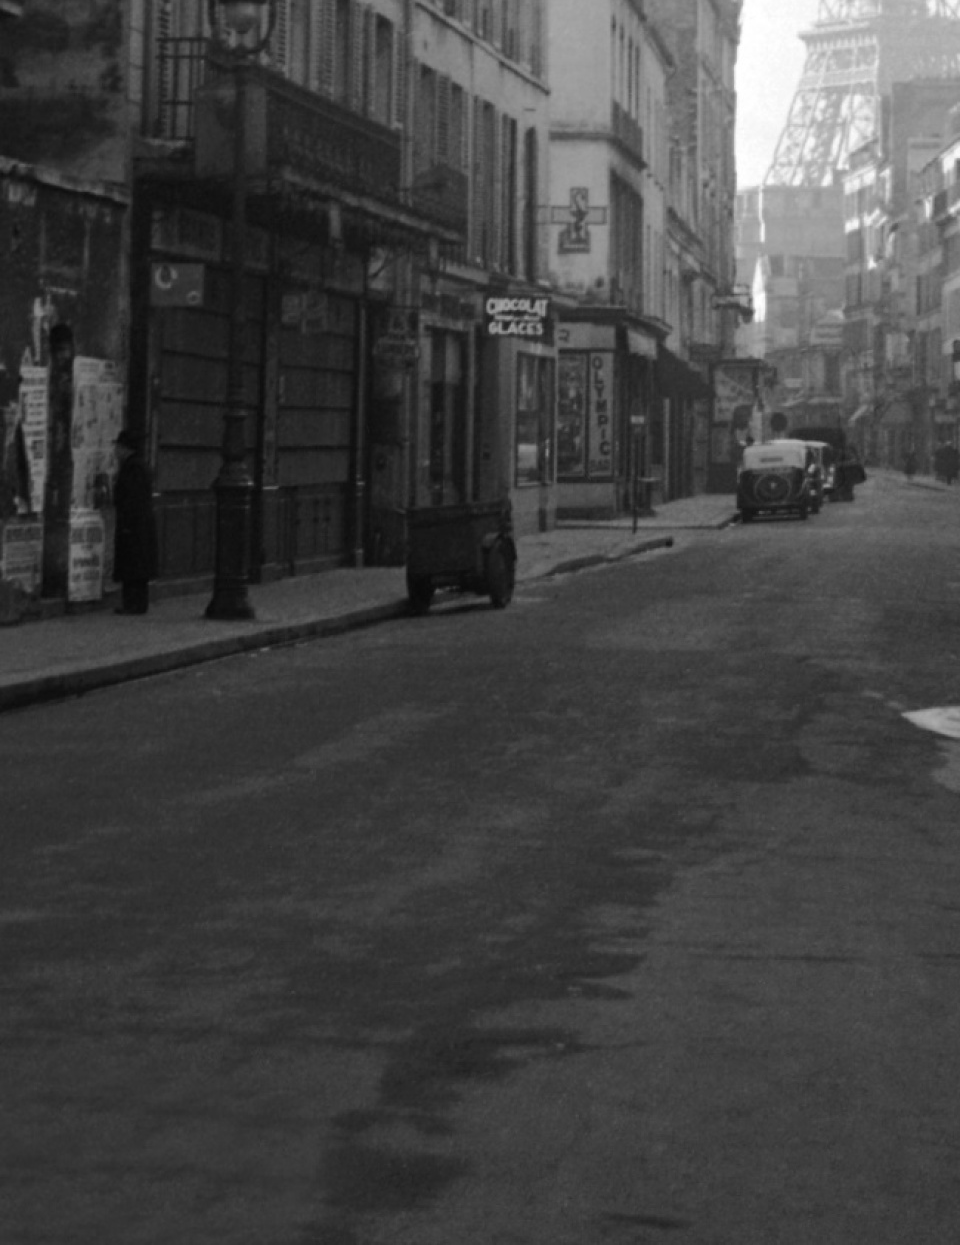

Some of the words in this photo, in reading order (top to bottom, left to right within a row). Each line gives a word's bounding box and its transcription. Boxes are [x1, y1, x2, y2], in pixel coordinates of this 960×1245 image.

[486, 297, 549, 317] CHOCOLAT
[488, 321, 544, 335] GLACES
[591, 356, 612, 456] OLYMPIC
